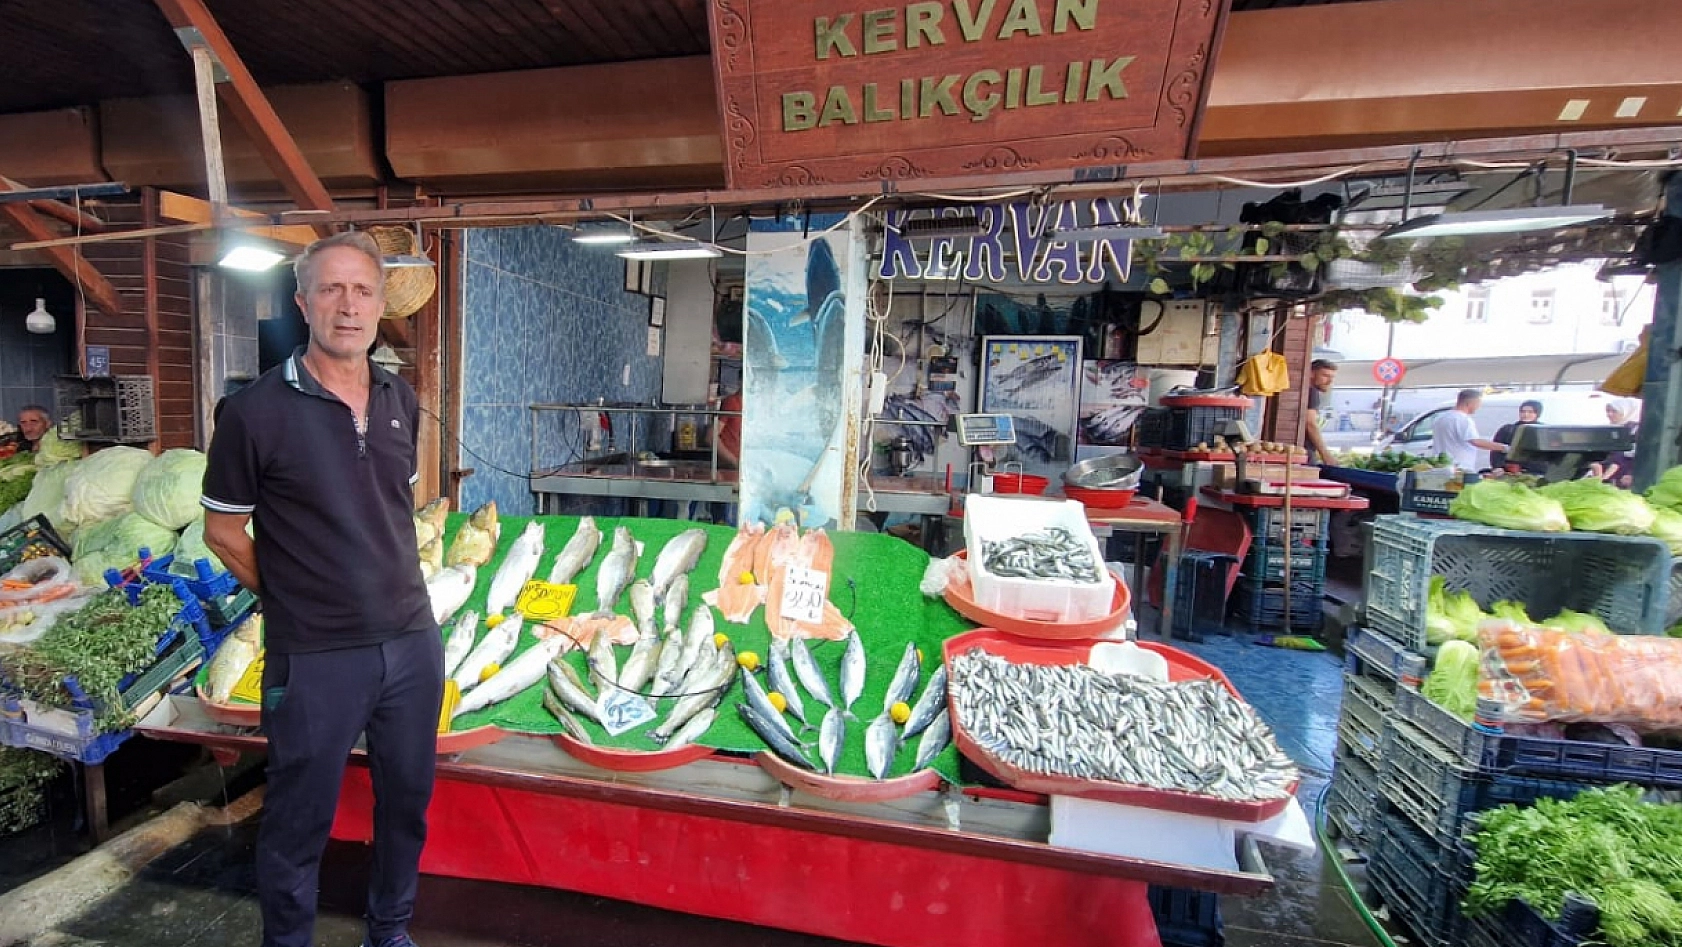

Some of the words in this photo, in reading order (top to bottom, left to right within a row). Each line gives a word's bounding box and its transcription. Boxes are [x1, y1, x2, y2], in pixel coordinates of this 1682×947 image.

[814, 0, 1099, 60] KERVAN
[782, 56, 1137, 132] BALIKÇILIK
[878, 199, 1140, 283] KERVAN
